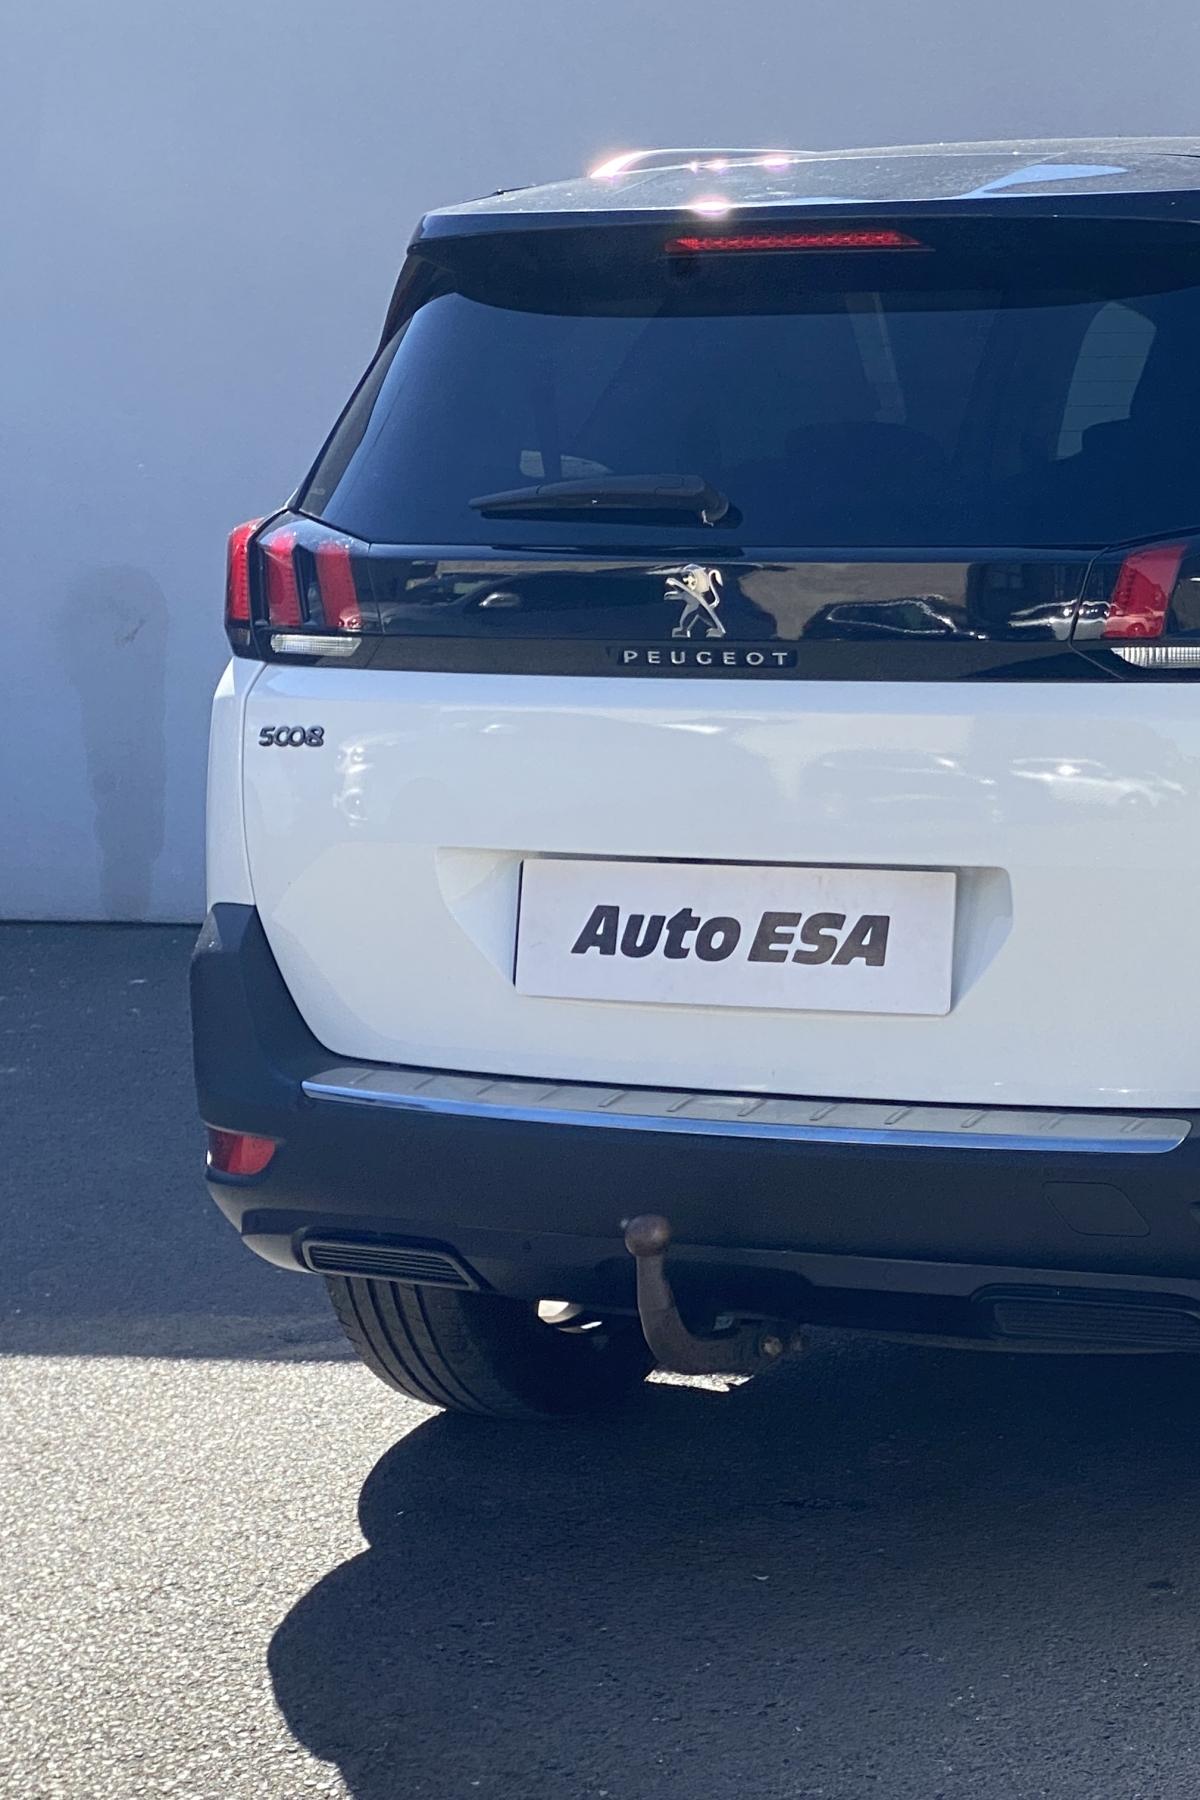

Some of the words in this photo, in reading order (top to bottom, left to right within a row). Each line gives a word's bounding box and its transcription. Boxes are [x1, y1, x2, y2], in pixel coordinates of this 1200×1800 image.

[623, 650, 788, 666] PEUGEOT
[258, 726, 325, 747] 5008
[570, 905, 742, 963] Auto
[747, 911, 891, 967] ESA
